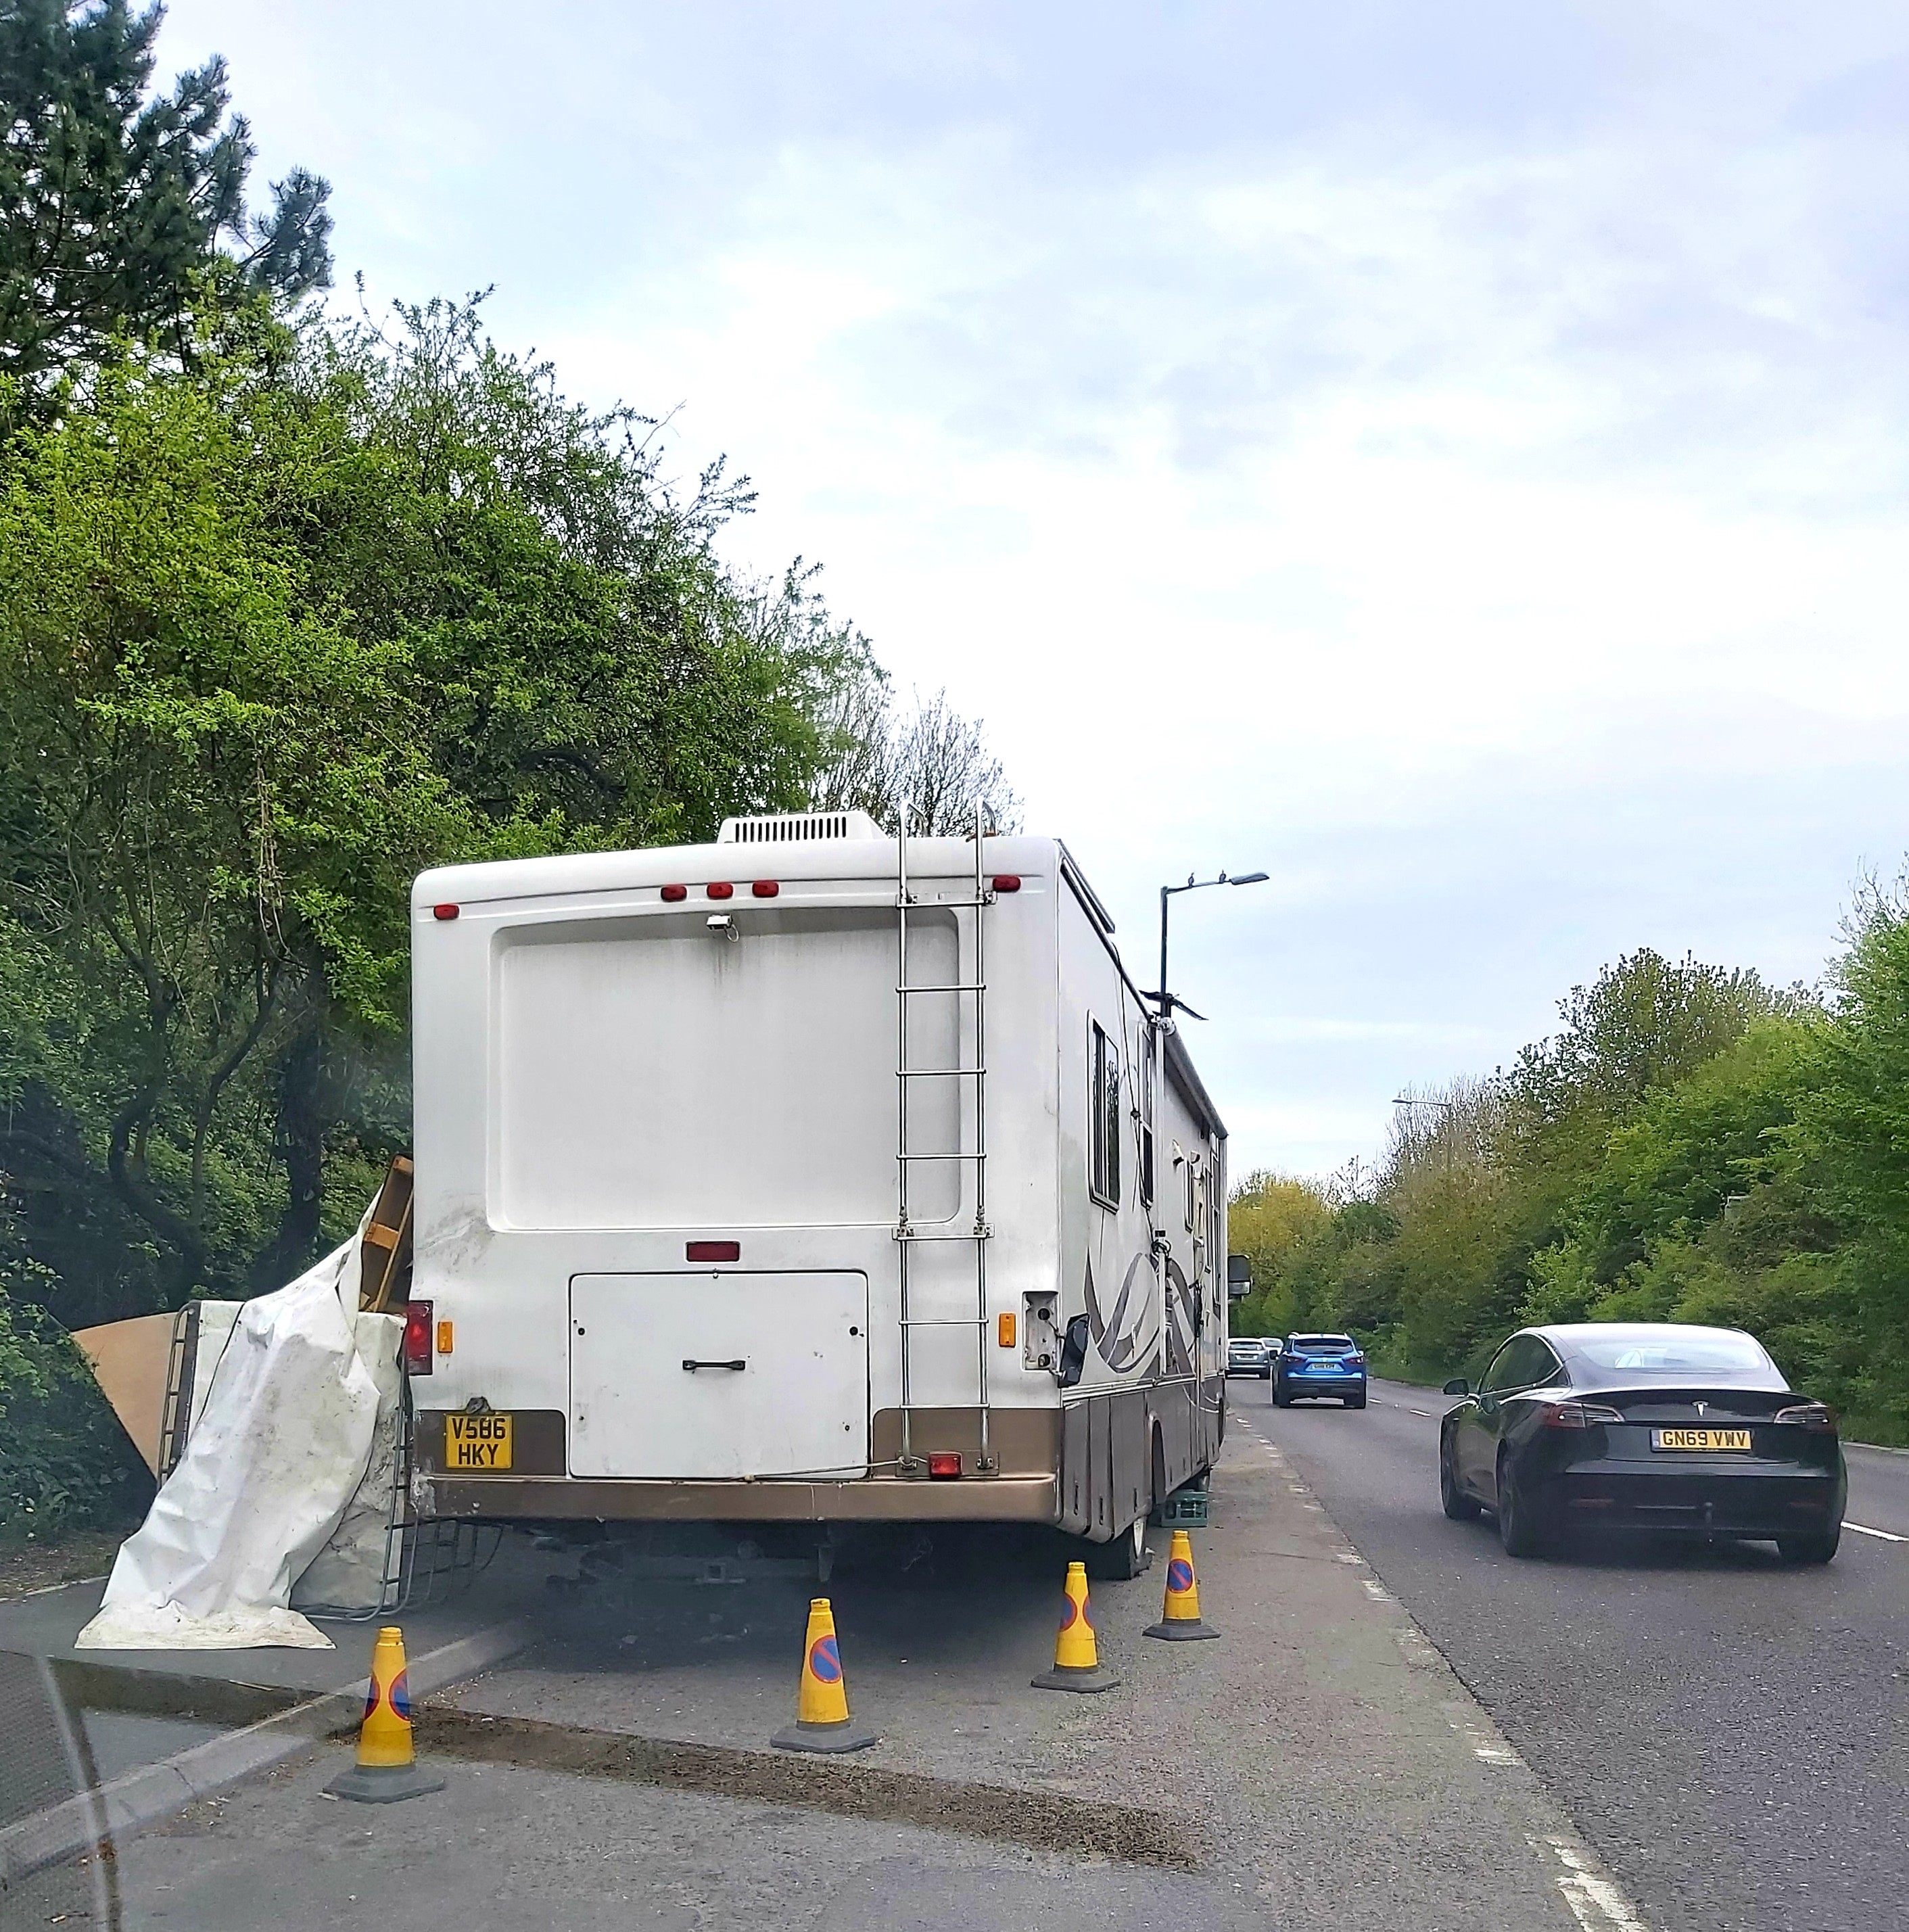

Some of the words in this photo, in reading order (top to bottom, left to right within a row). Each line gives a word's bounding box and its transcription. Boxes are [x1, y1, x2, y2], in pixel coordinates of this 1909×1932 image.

[1663, 1431, 1707, 1446] GN69
[1713, 1432, 1746, 1446] VWV
[458, 1444, 499, 1465] HKY
